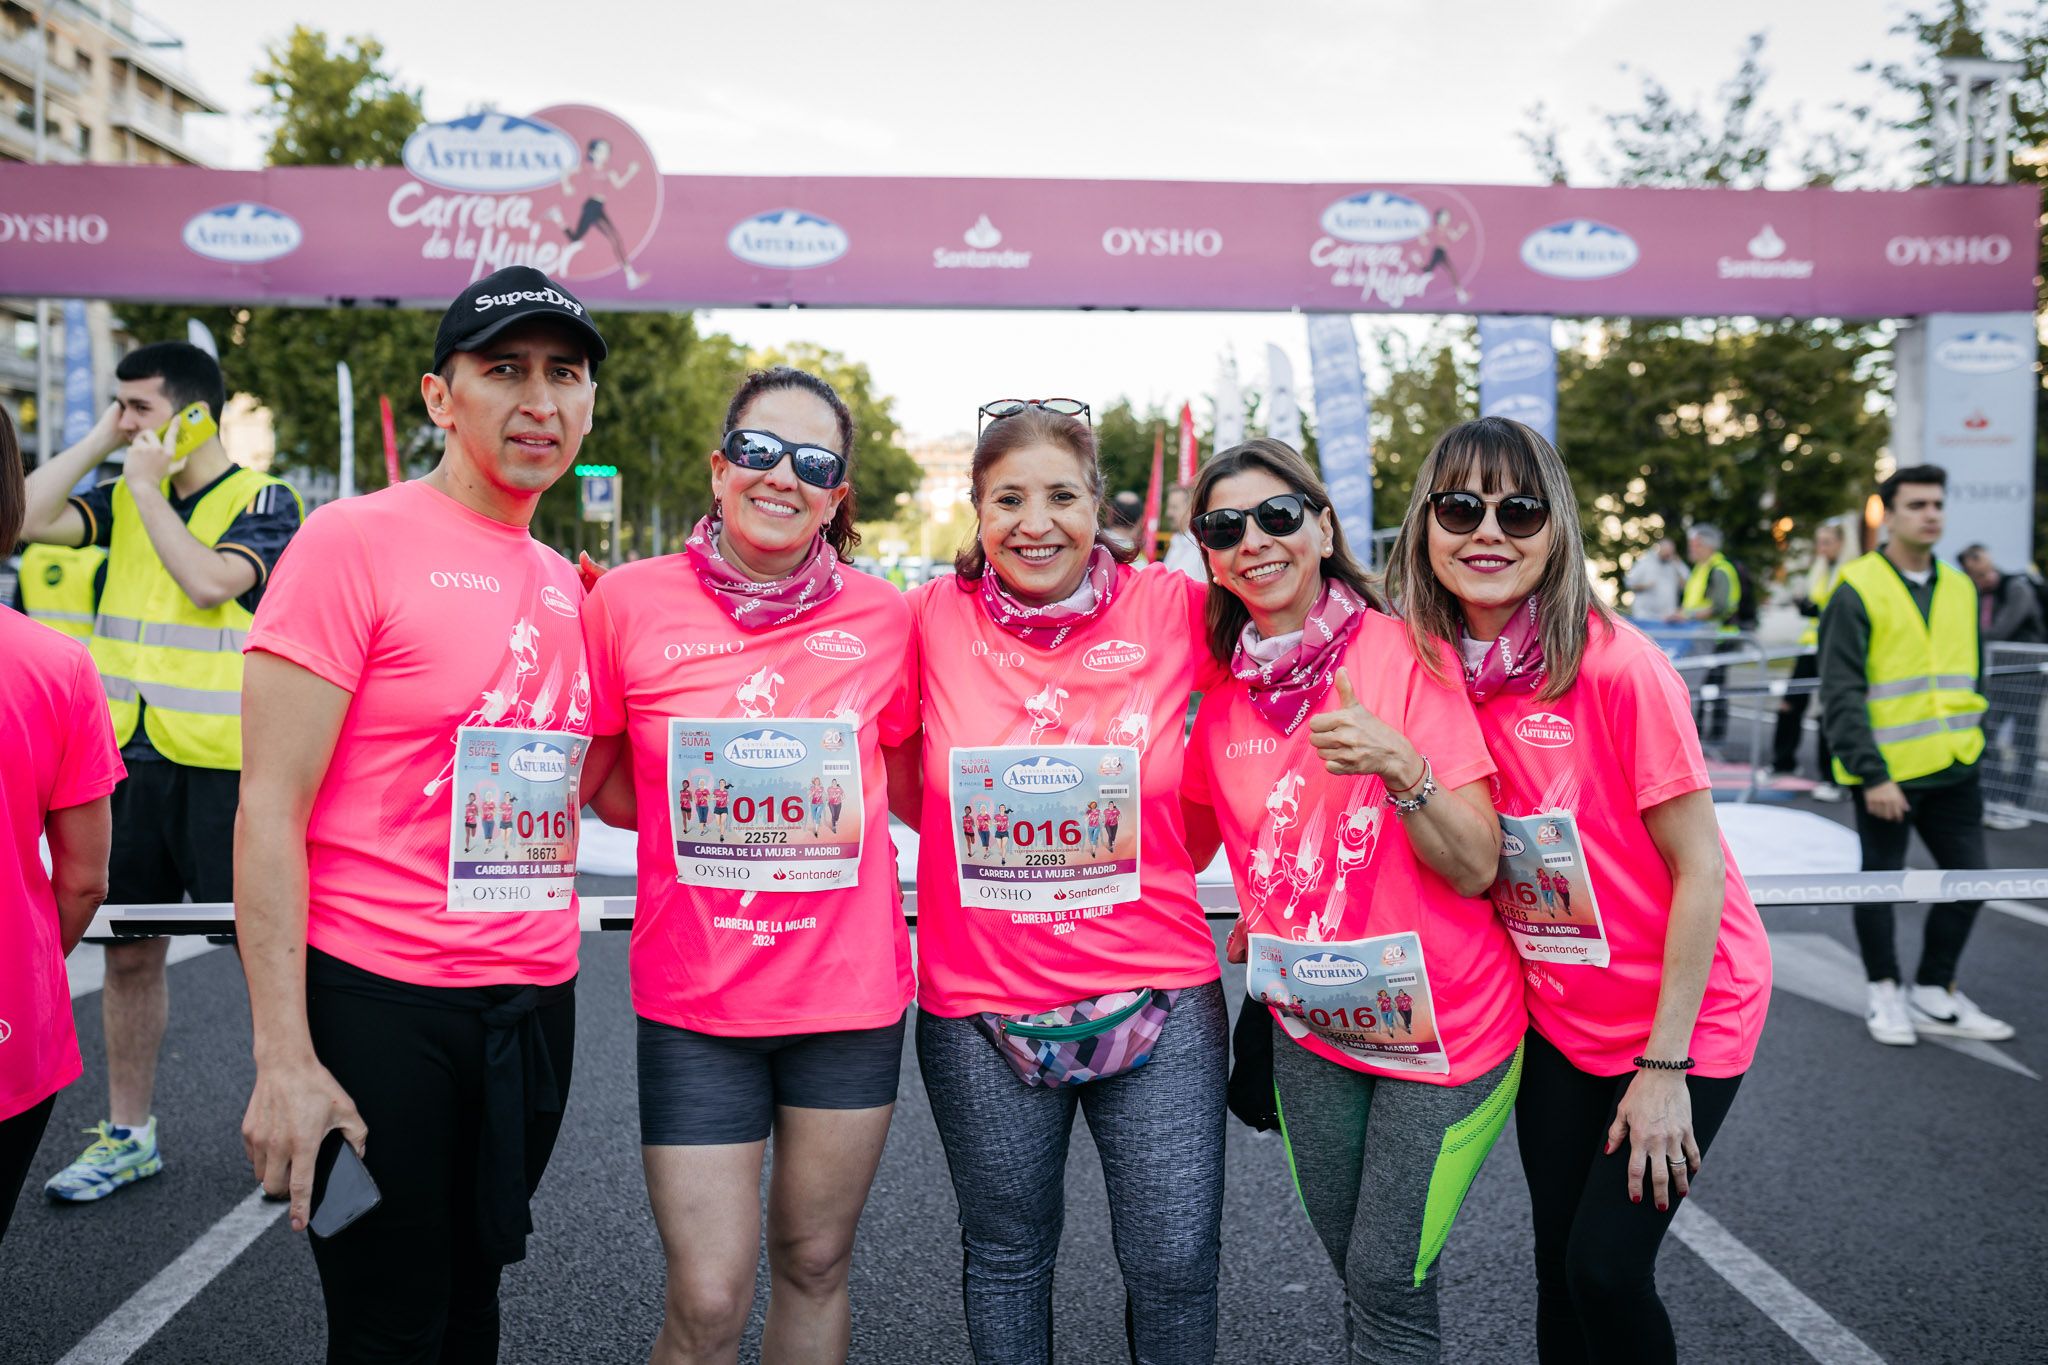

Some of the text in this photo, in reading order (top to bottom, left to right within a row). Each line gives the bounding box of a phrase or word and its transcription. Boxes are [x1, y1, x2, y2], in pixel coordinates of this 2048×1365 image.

[421, 141, 563, 169] ASTURIANA
[388, 182, 533, 228] Carrera
[1103, 228, 1223, 256] OYSHO
[1886, 235, 2012, 265] OYSHO
[933, 247, 1031, 269] Santander
[1718, 257, 1814, 280] Santander
[430, 572, 500, 592] OYSHO
[664, 640, 744, 660] OYSHO
[810, 640, 861, 655] ASTURIANA
[1088, 652, 1141, 666] ASTURIANA
[1520, 724, 1572, 740] ASTURIANA
[681, 736, 711, 747] SUMA
[729, 744, 802, 760] ASTURIANA
[961, 764, 990, 774] SUMA
[1008, 771, 1078, 785] ASTURIANA
[733, 796, 804, 823] 016
[517, 811, 565, 839] 016
[1540, 825, 1557, 838] 20
[745, 832, 787, 843] 22572
[1013, 820, 1082, 846] 016
[527, 848, 557, 860] 18673
[695, 846, 841, 857] CARRERA DE LA MUJER MADRID
[1025, 854, 1066, 866] 22693
[475, 864, 518, 875] CARRERA
[519, 864, 529, 874] DE
[530, 864, 540, 874] LA
[542, 863, 561, 874] MUJER
[695, 864, 842, 880] OYSHO Santander
[979, 865, 1117, 879] CARRERA DE LA MUJER MADRID
[473, 886, 531, 900] OYSHO
[980, 884, 1120, 901] OYSHO Santander
[1496, 880, 1537, 905] 16
[1011, 905, 1113, 924] CARRERA DE LA MUJER
[714, 917, 816, 932] CARRERA DE LA MUJER
[1053, 921, 1076, 936] 2024
[1516, 922, 1539, 932] MUJER
[1546, 926, 1580, 935] MADRID
[752, 934, 775, 946] 2024
[1536, 944, 1588, 956] Santander
[1297, 964, 1363, 978] ASTURIANA
[1528, 971, 1542, 989] 2024
[1310, 1007, 1376, 1028] 016
[1350, 1041, 1378, 1050] MUJER
